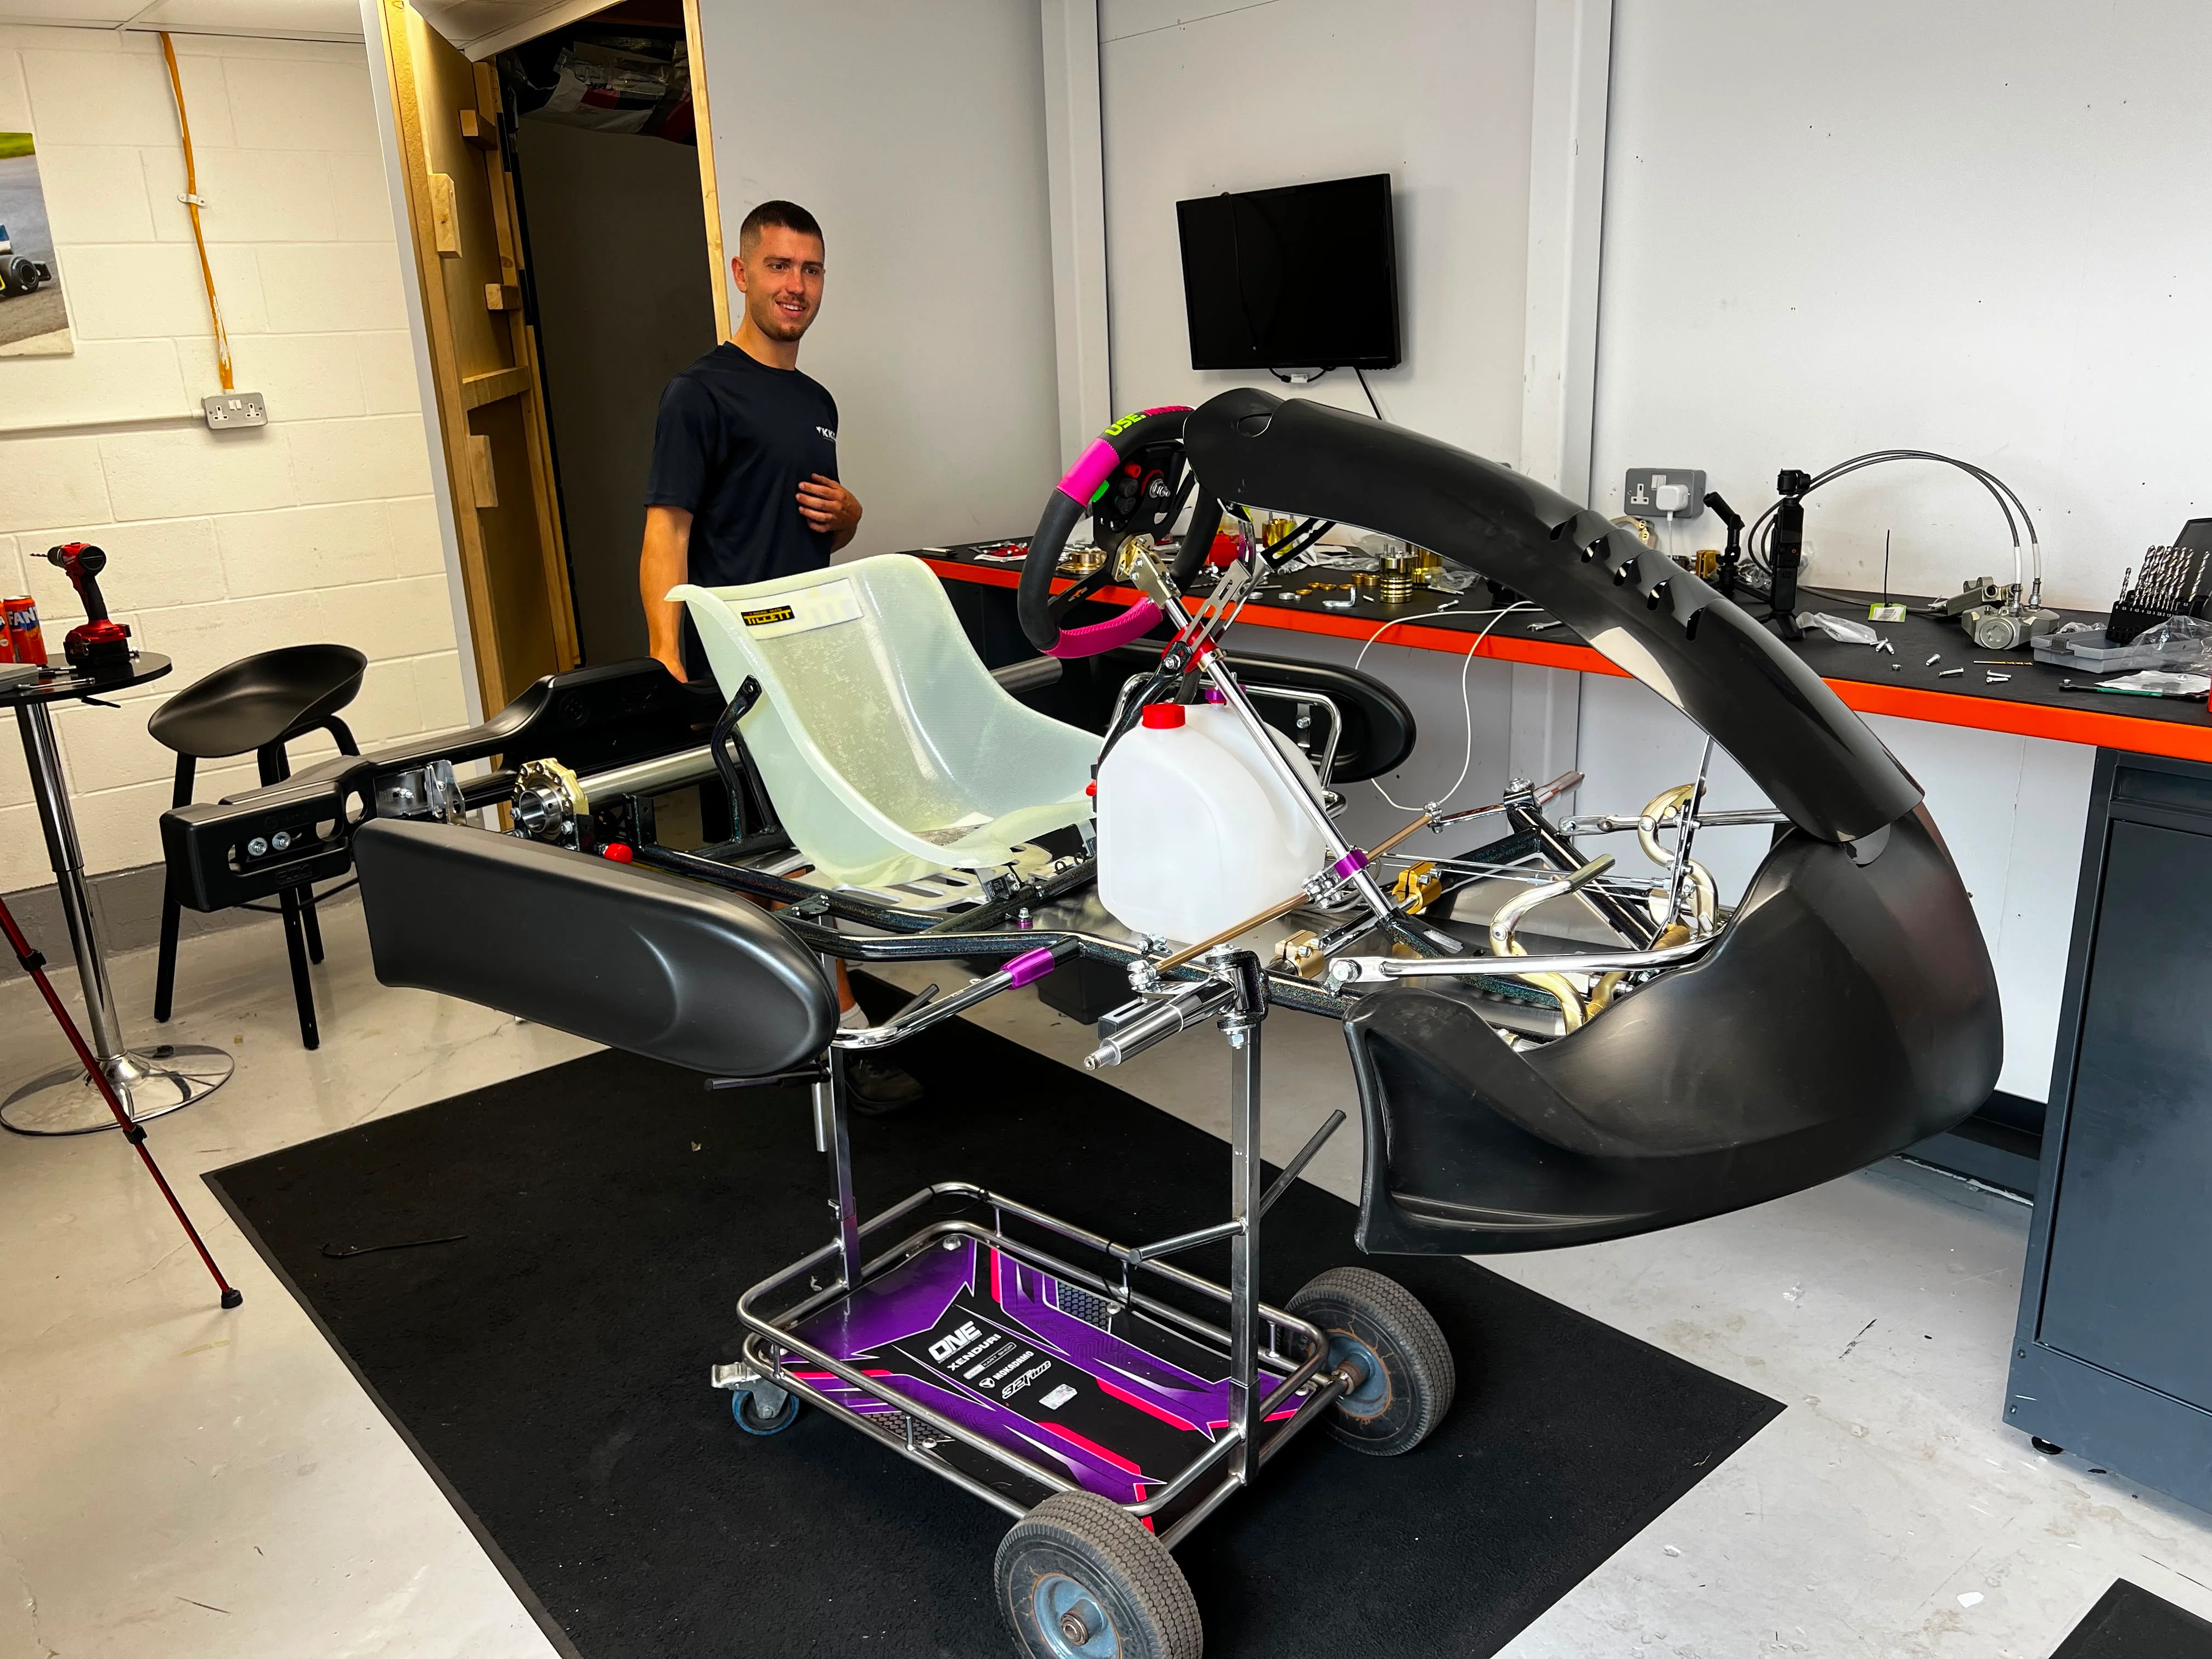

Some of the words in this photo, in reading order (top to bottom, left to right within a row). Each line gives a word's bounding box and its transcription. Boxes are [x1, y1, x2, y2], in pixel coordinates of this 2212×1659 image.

[743, 609, 791, 625] TILLETT
[928, 1321, 981, 1361] ONE
[947, 1334, 1002, 1371] XENDURI
[992, 1351, 1035, 1380] MOKADAMO
